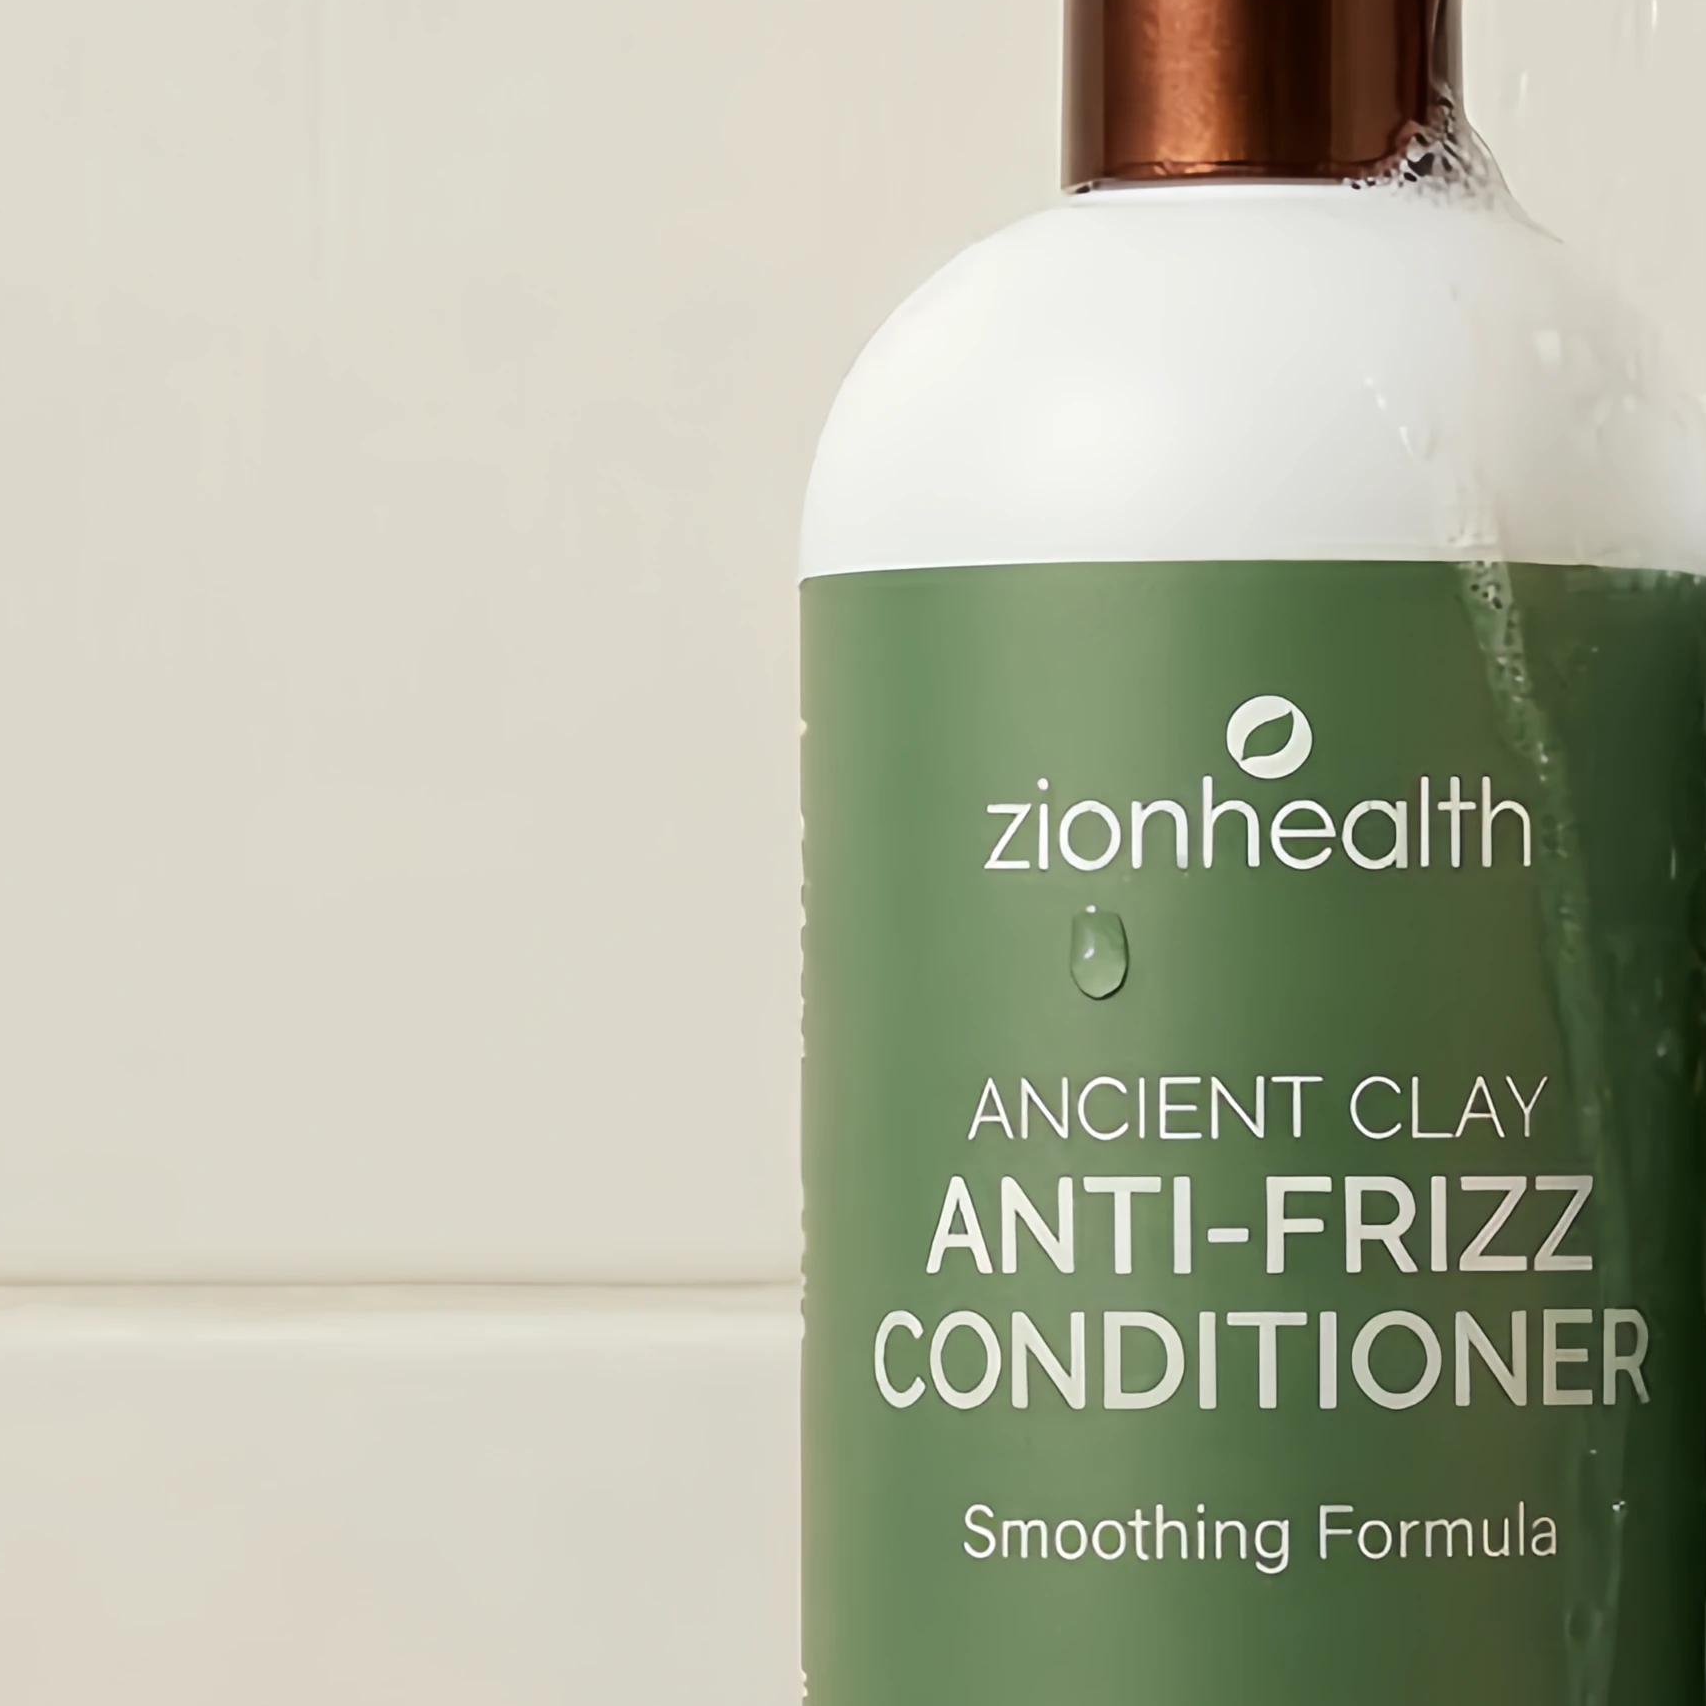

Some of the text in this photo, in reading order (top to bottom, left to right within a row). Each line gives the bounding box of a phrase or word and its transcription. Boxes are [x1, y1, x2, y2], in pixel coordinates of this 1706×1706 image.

[984, 776, 1531, 870] zionhealth
[968, 1076, 1547, 1140] ANCIENT CLAY
[926, 1176, 1593, 1274] ANTI-FRIZZ
[875, 1309, 1649, 1409] CONDITIONER
[964, 1501, 1556, 1574] Smoothing Formula
